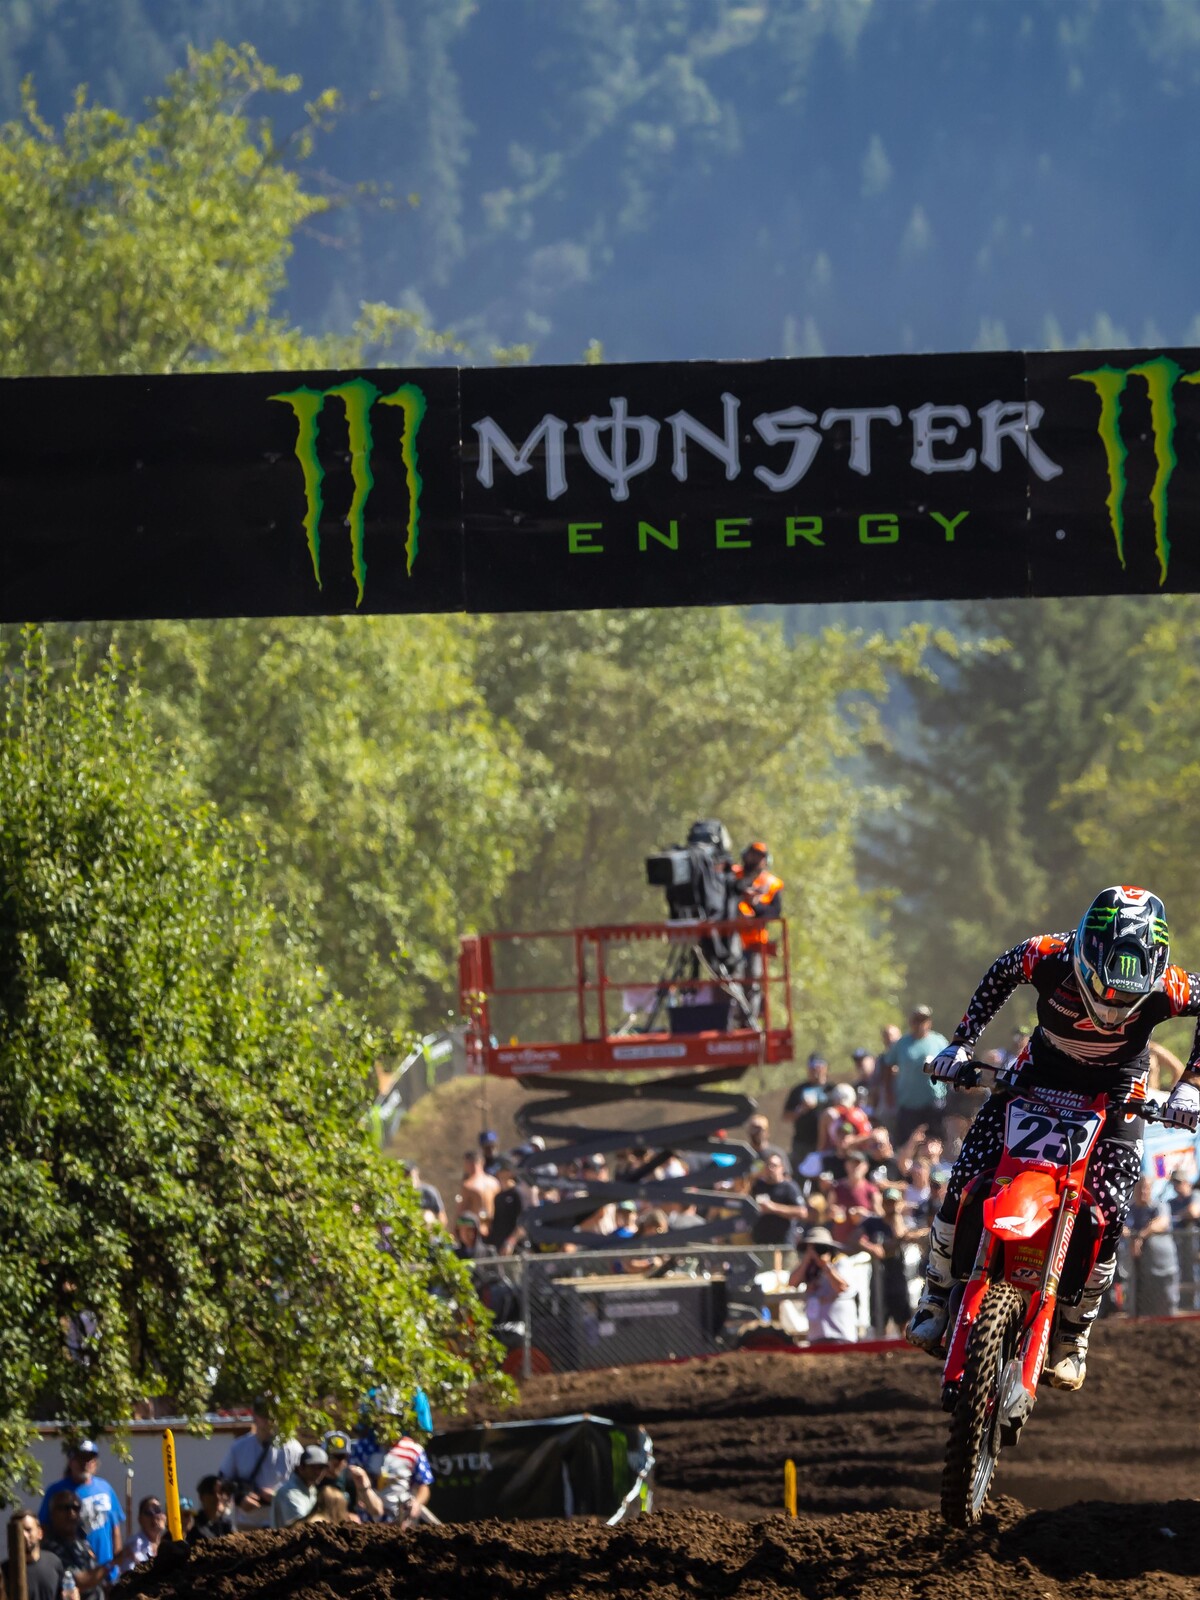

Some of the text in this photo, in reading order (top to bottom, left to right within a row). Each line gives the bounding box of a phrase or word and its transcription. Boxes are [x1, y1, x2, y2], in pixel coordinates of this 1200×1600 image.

[472, 392, 1063, 501] MONSTER
[568, 511, 970, 554] ENERGY
[1109, 978, 1144, 990] MONSTER
[1047, 998, 1080, 1019] SHOWA
[1060, 1109, 1074, 1118] OIL
[1007, 1115, 1088, 1165] 23
[1031, 1317, 1050, 1389] DUNLOP
